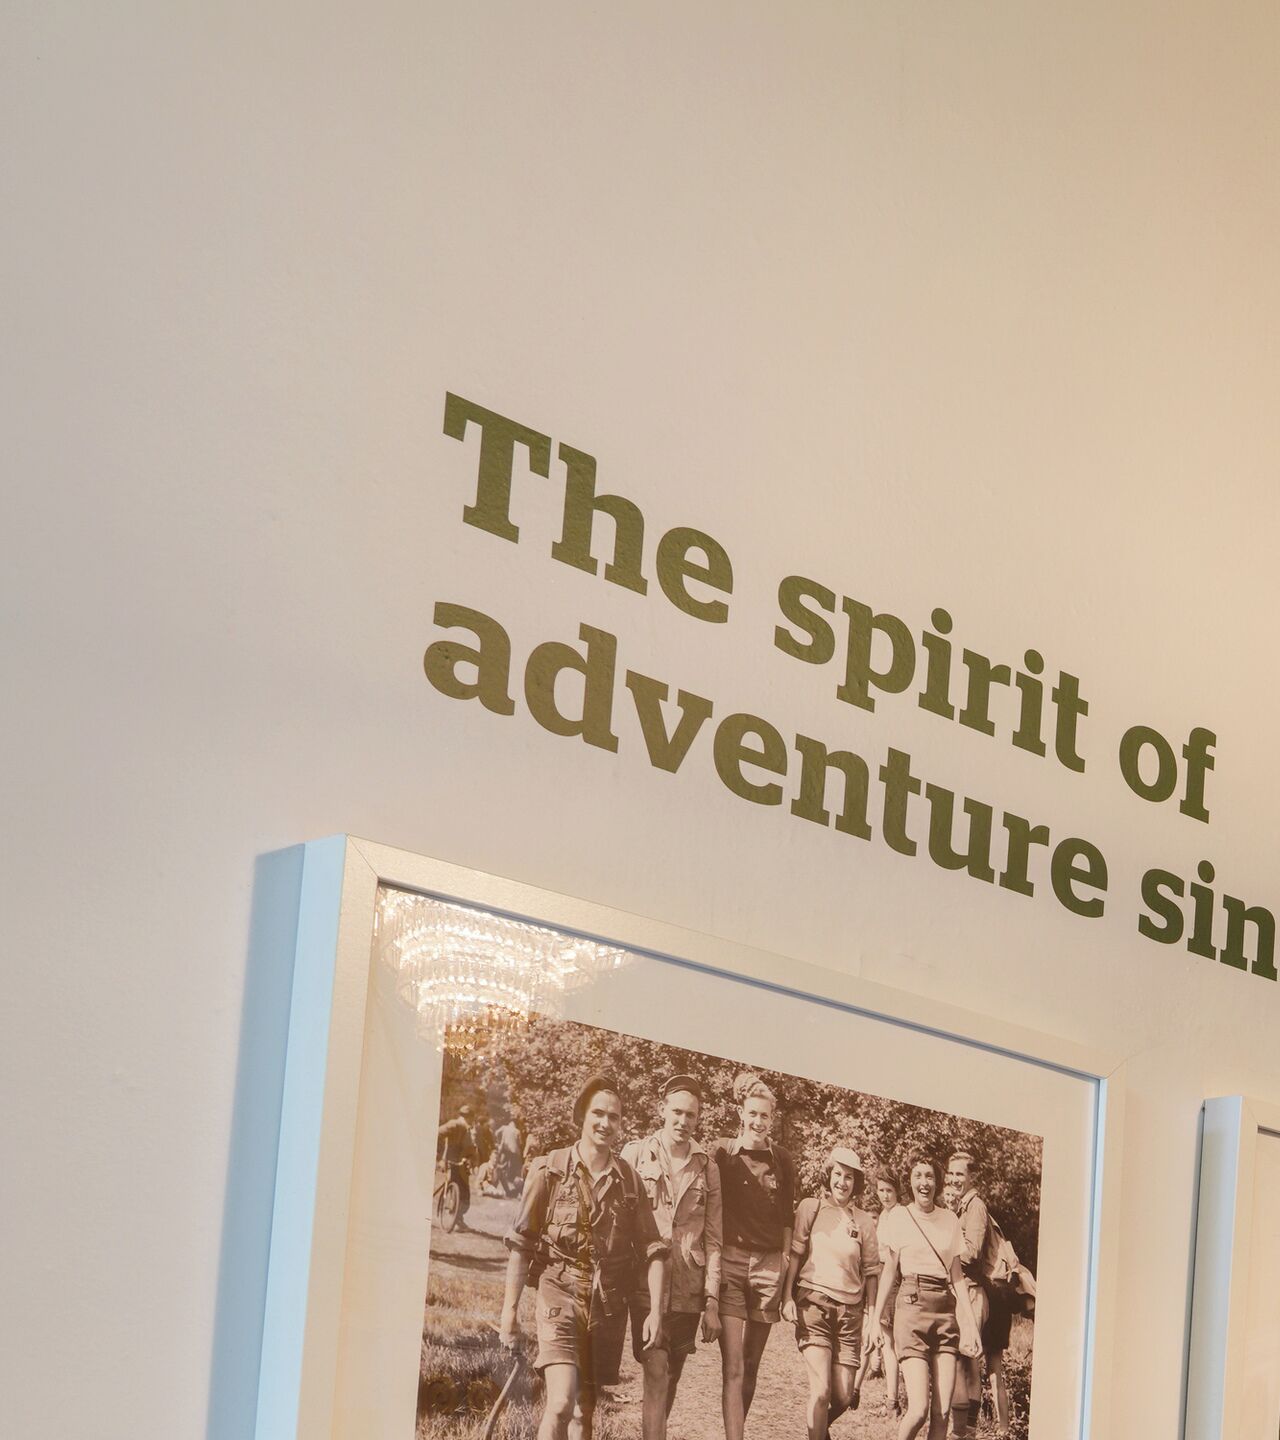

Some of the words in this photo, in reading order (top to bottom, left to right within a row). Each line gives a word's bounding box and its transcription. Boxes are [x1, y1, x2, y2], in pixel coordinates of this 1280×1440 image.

[423, 601, 1108, 918] adventure
[444, 391, 733, 624] The
[775, 575, 1088, 774] spirit
[1119, 727, 1216, 824] of
